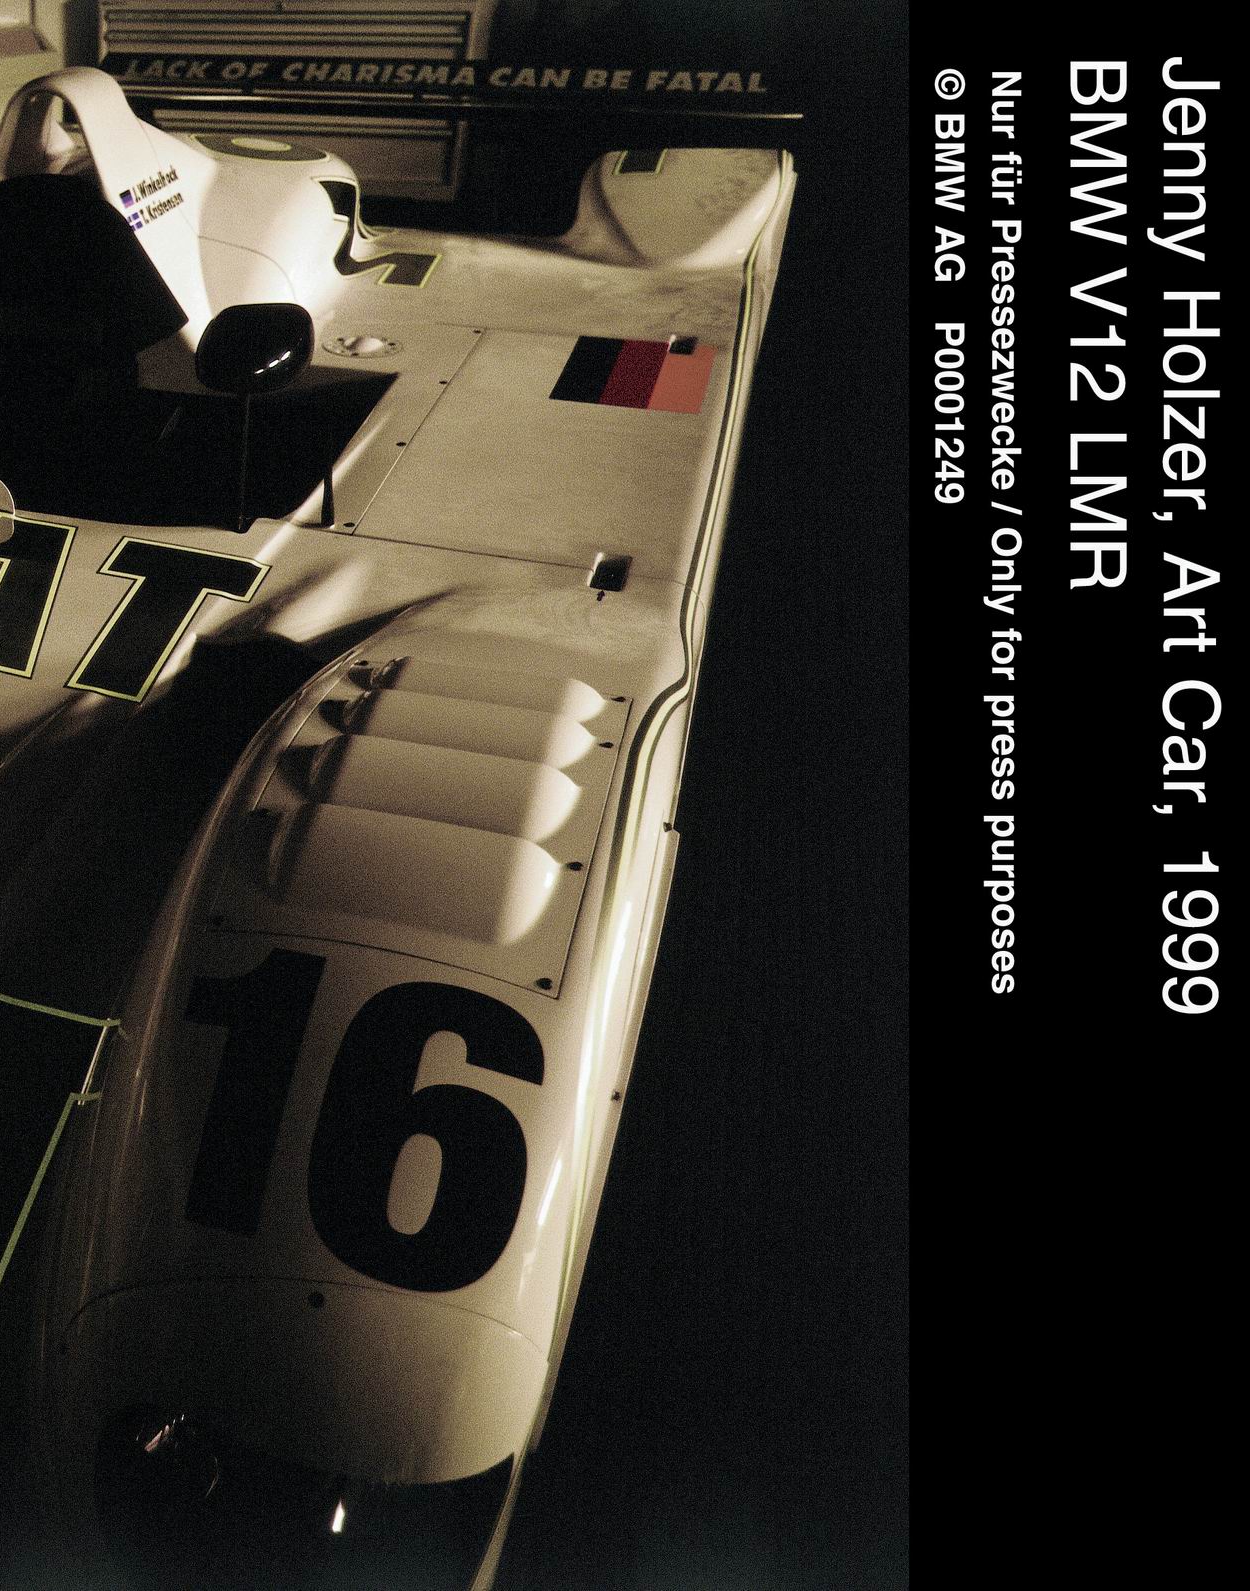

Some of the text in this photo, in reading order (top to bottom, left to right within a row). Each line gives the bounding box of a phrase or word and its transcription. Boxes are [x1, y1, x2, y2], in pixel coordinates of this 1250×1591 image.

[122, 58, 768, 93] LACK OF CHARISMA CAN BE FATAL
[184, 948, 545, 1293] 16
